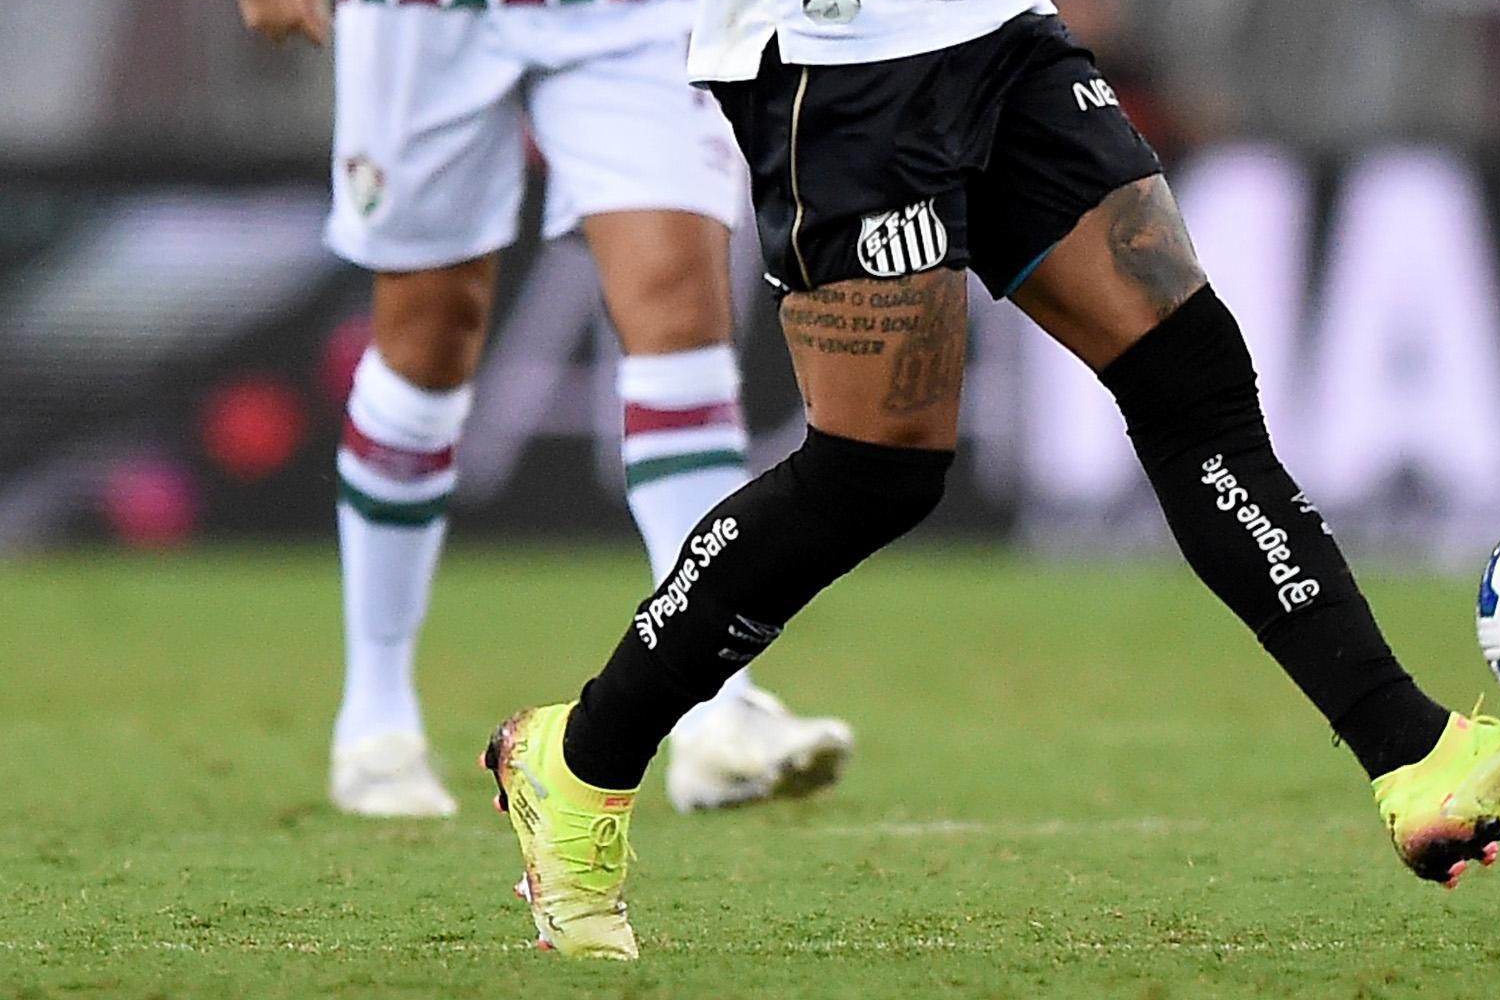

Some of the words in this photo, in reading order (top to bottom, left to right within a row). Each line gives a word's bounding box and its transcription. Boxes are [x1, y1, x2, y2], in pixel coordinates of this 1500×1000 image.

[1201, 453, 1249, 512] Safe
[649, 558, 699, 627] Pague
[690, 516, 739, 568] Safe
[1236, 503, 1301, 586] Pague
